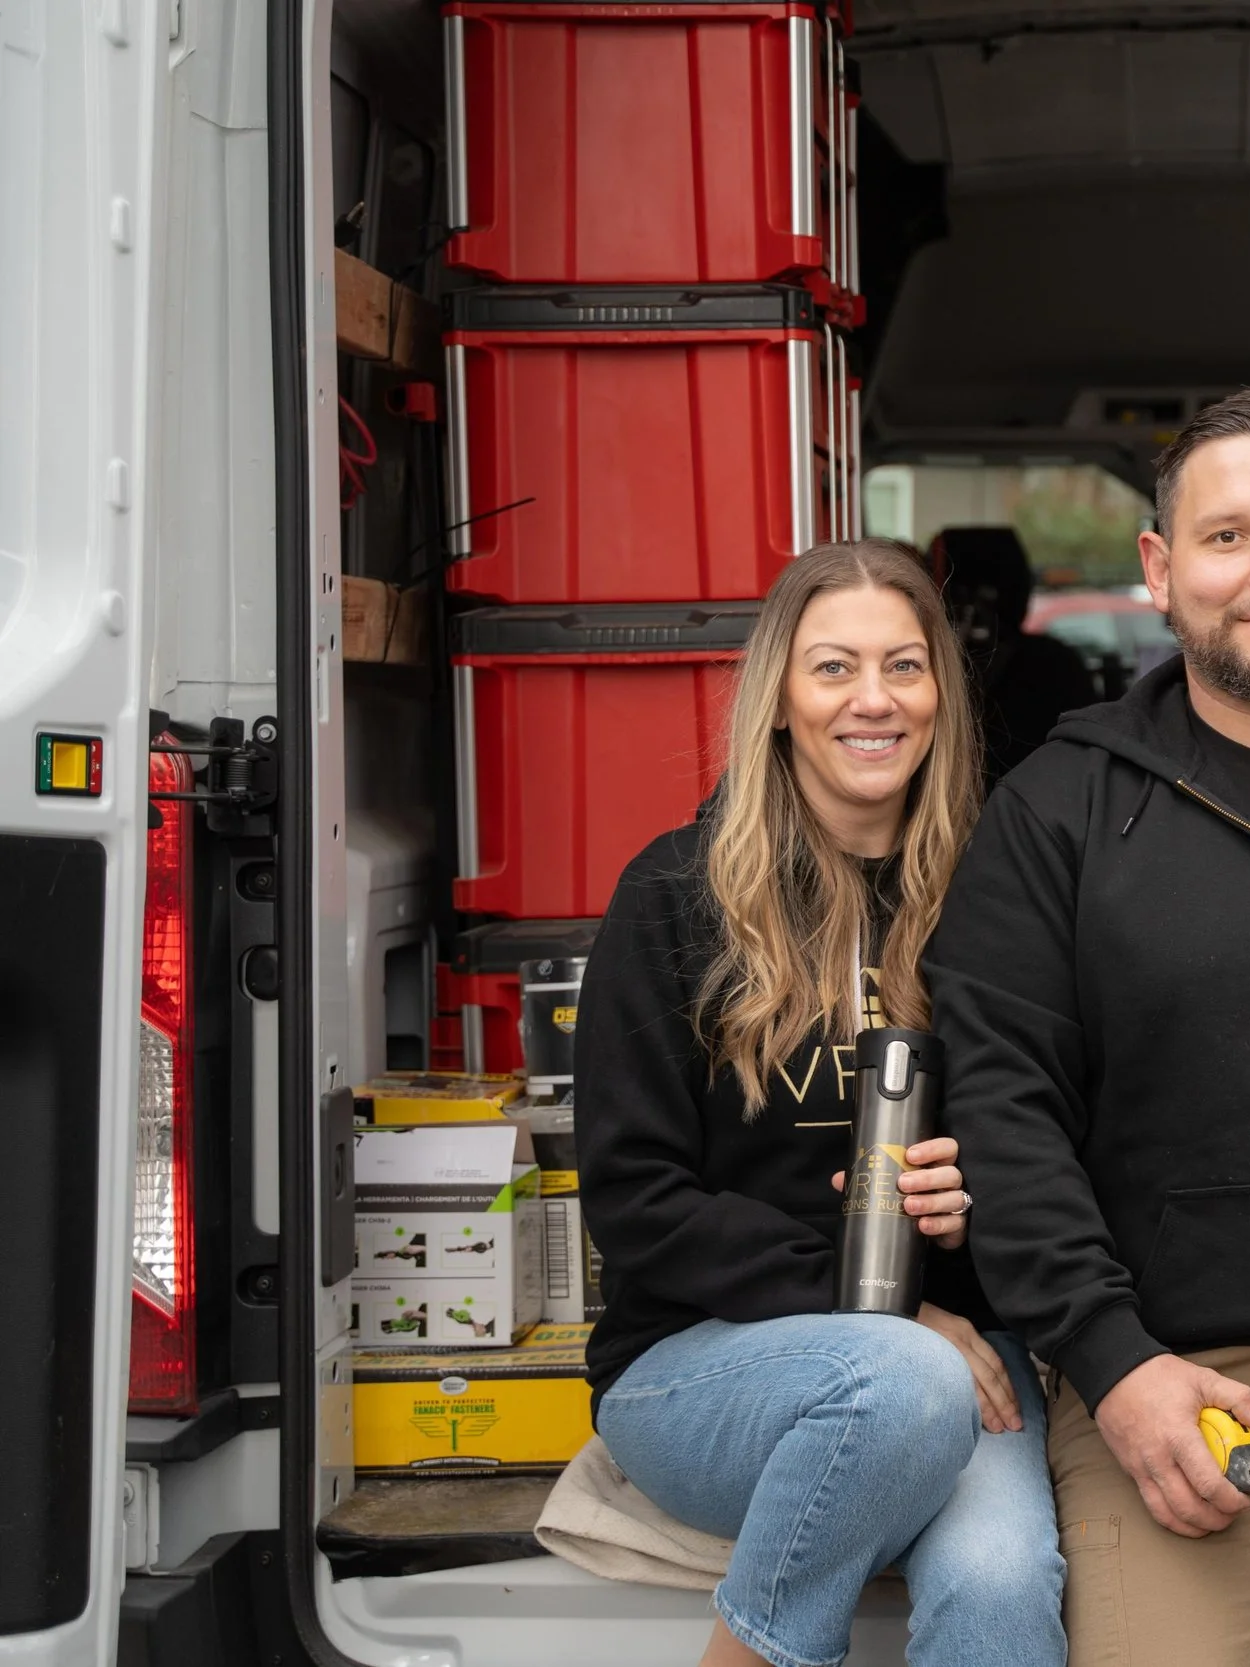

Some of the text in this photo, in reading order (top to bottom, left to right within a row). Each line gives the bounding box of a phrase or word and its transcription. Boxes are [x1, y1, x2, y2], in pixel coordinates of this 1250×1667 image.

[363, 1195, 410, 1203] HERRAMIENTA
[415, 1195, 461, 1203] CHARGEMENT
[462, 1195, 471, 1203] DE
[859, 1277, 896, 1289] contigo
[450, 1404, 496, 1414] FASTENERS
